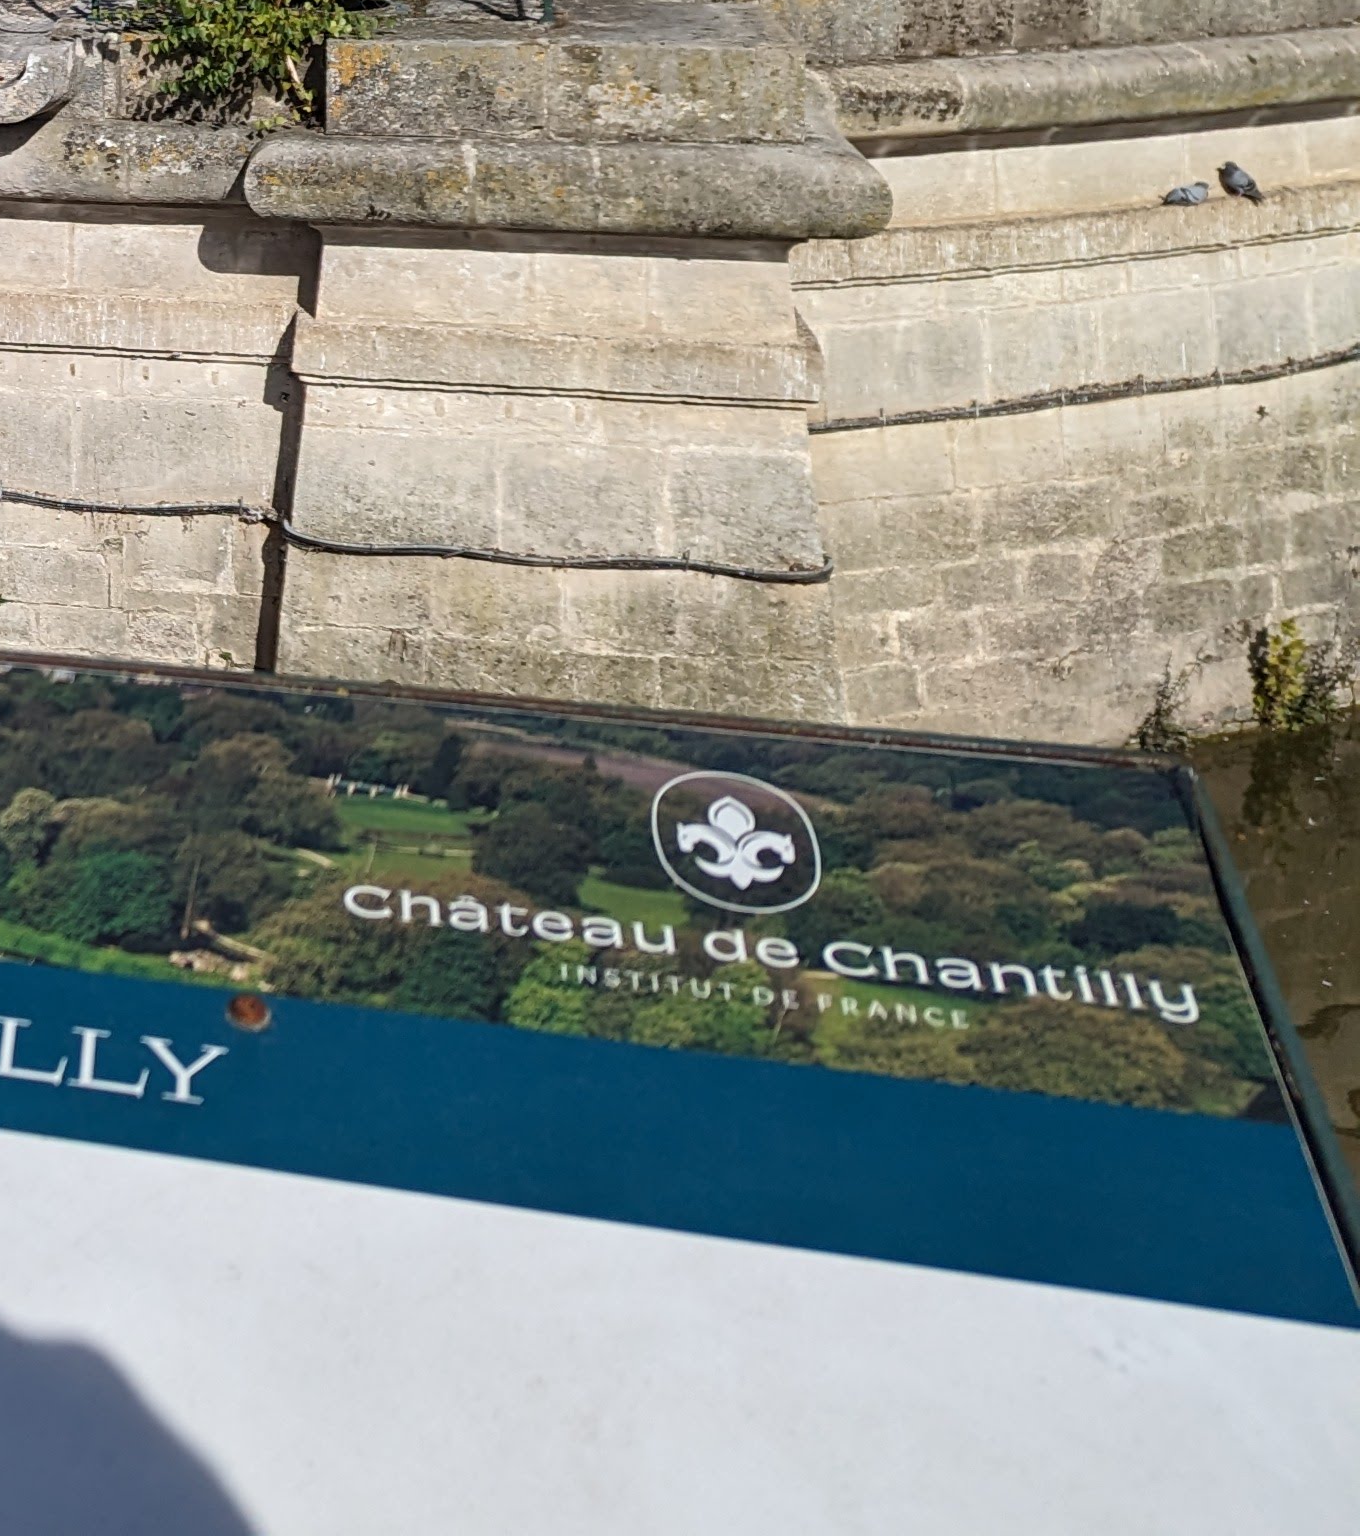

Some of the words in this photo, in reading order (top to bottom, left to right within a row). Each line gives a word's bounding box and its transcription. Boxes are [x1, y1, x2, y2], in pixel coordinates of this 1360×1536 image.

[342, 883, 677, 956] Château
[702, 927, 800, 969] de
[822, 940, 1201, 1024] Chantilly
[559, 964, 736, 1002] INSTITUT
[752, 986, 801, 1011] DE
[816, 992, 971, 1030] FRANCE
